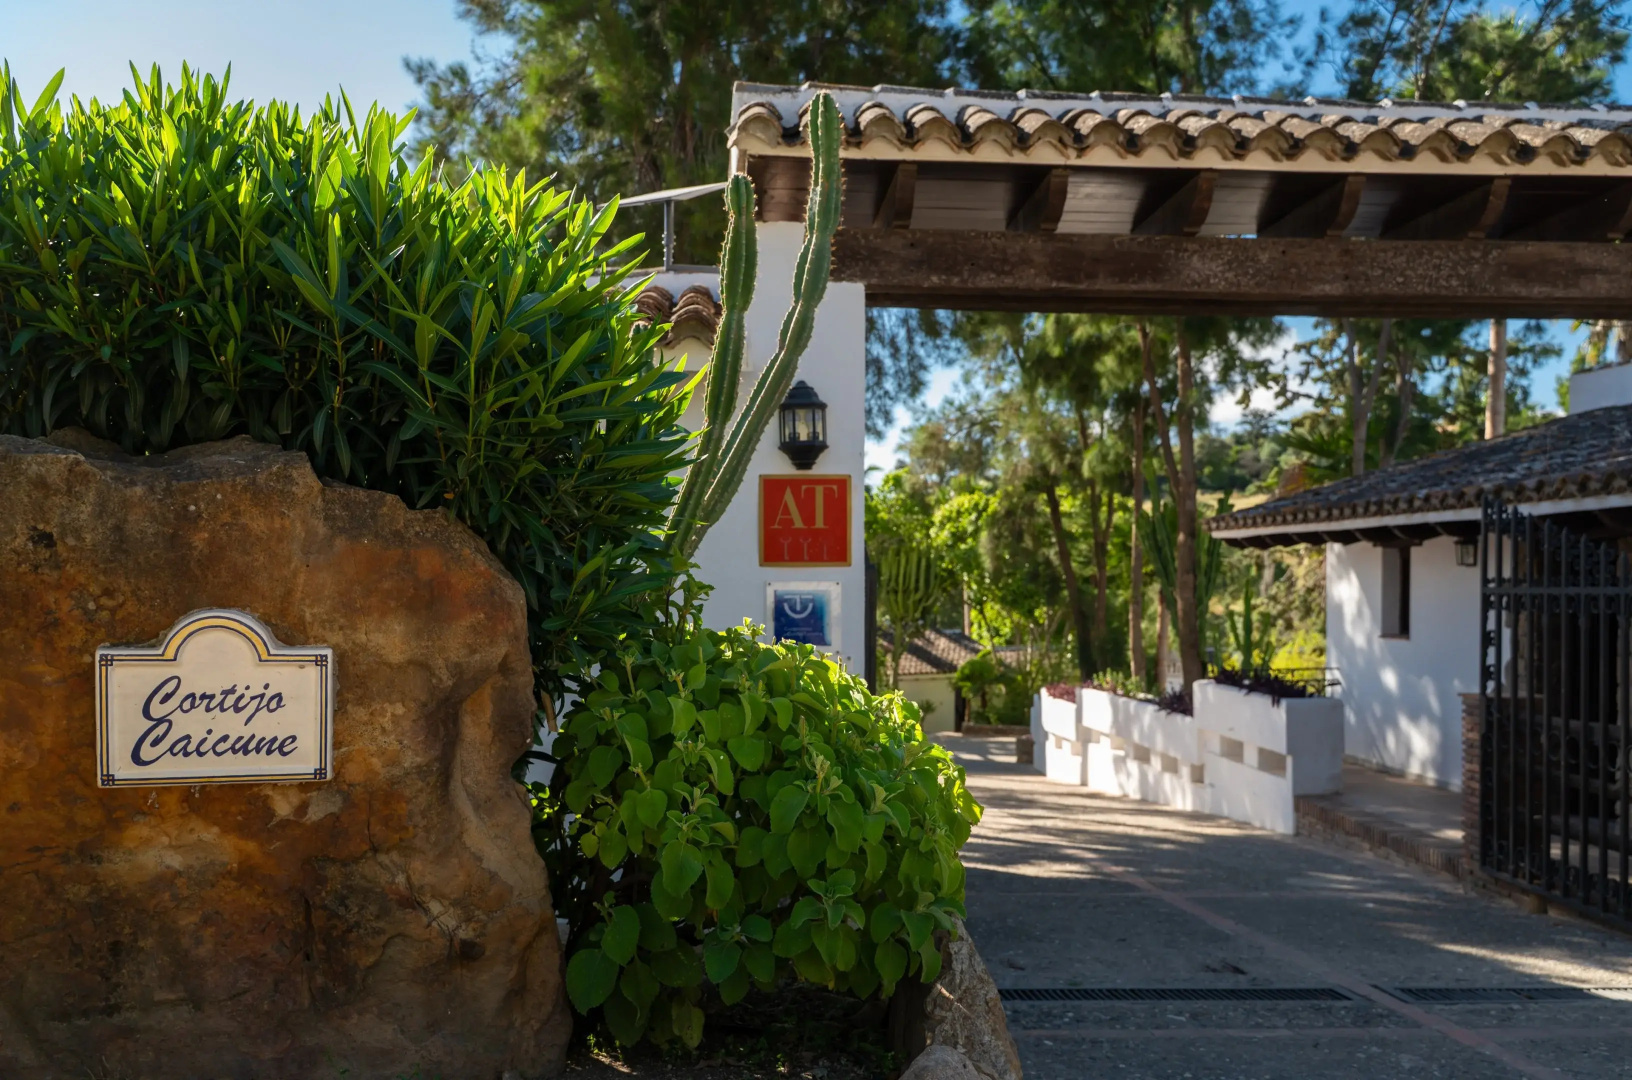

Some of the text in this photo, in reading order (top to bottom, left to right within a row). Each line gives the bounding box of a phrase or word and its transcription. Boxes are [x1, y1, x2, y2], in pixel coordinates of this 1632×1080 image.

[770, 485, 838, 529] AT
[142, 675, 286, 726] Cortijo
[131, 718, 298, 766] Caicune
